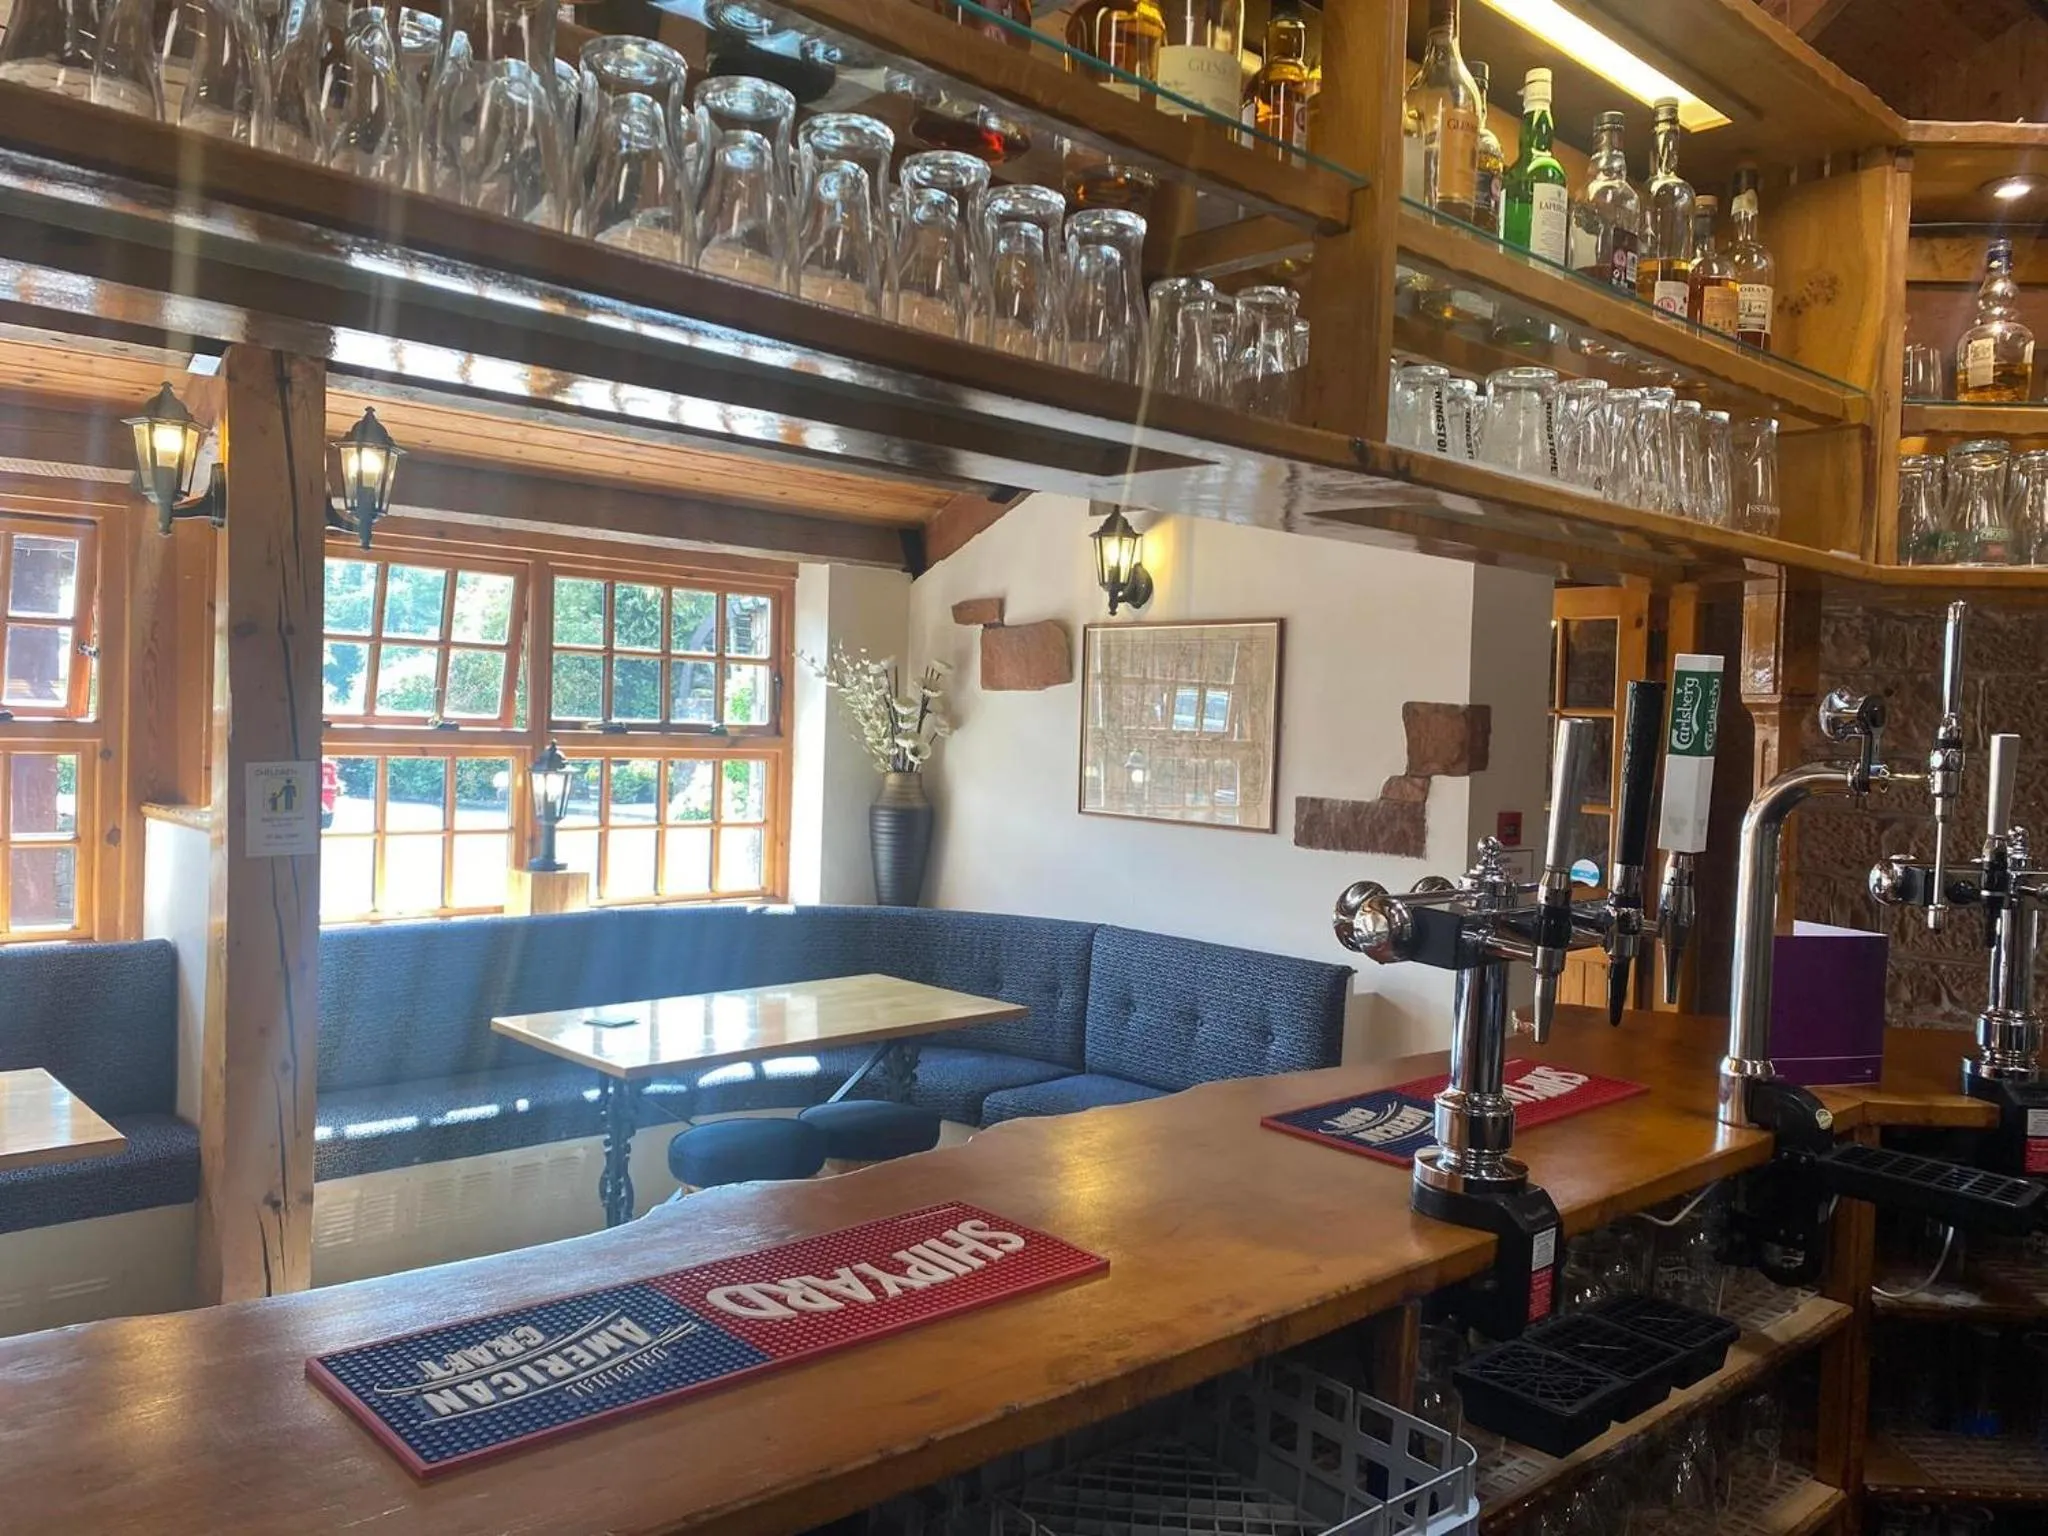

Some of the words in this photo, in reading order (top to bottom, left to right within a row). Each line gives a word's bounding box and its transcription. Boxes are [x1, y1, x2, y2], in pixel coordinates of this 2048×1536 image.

[1465, 411, 1475, 460] KINGST
[1671, 676, 1701, 750] Carlsberg
[1704, 678, 1720, 751] Carlsberg
[705, 1219, 1026, 1320] SHIPYARD
[415, 1324, 545, 1380] CRAFT
[421, 1316, 652, 1417] AMERICAN
[564, 1345, 669, 1398] ORIGINAL
